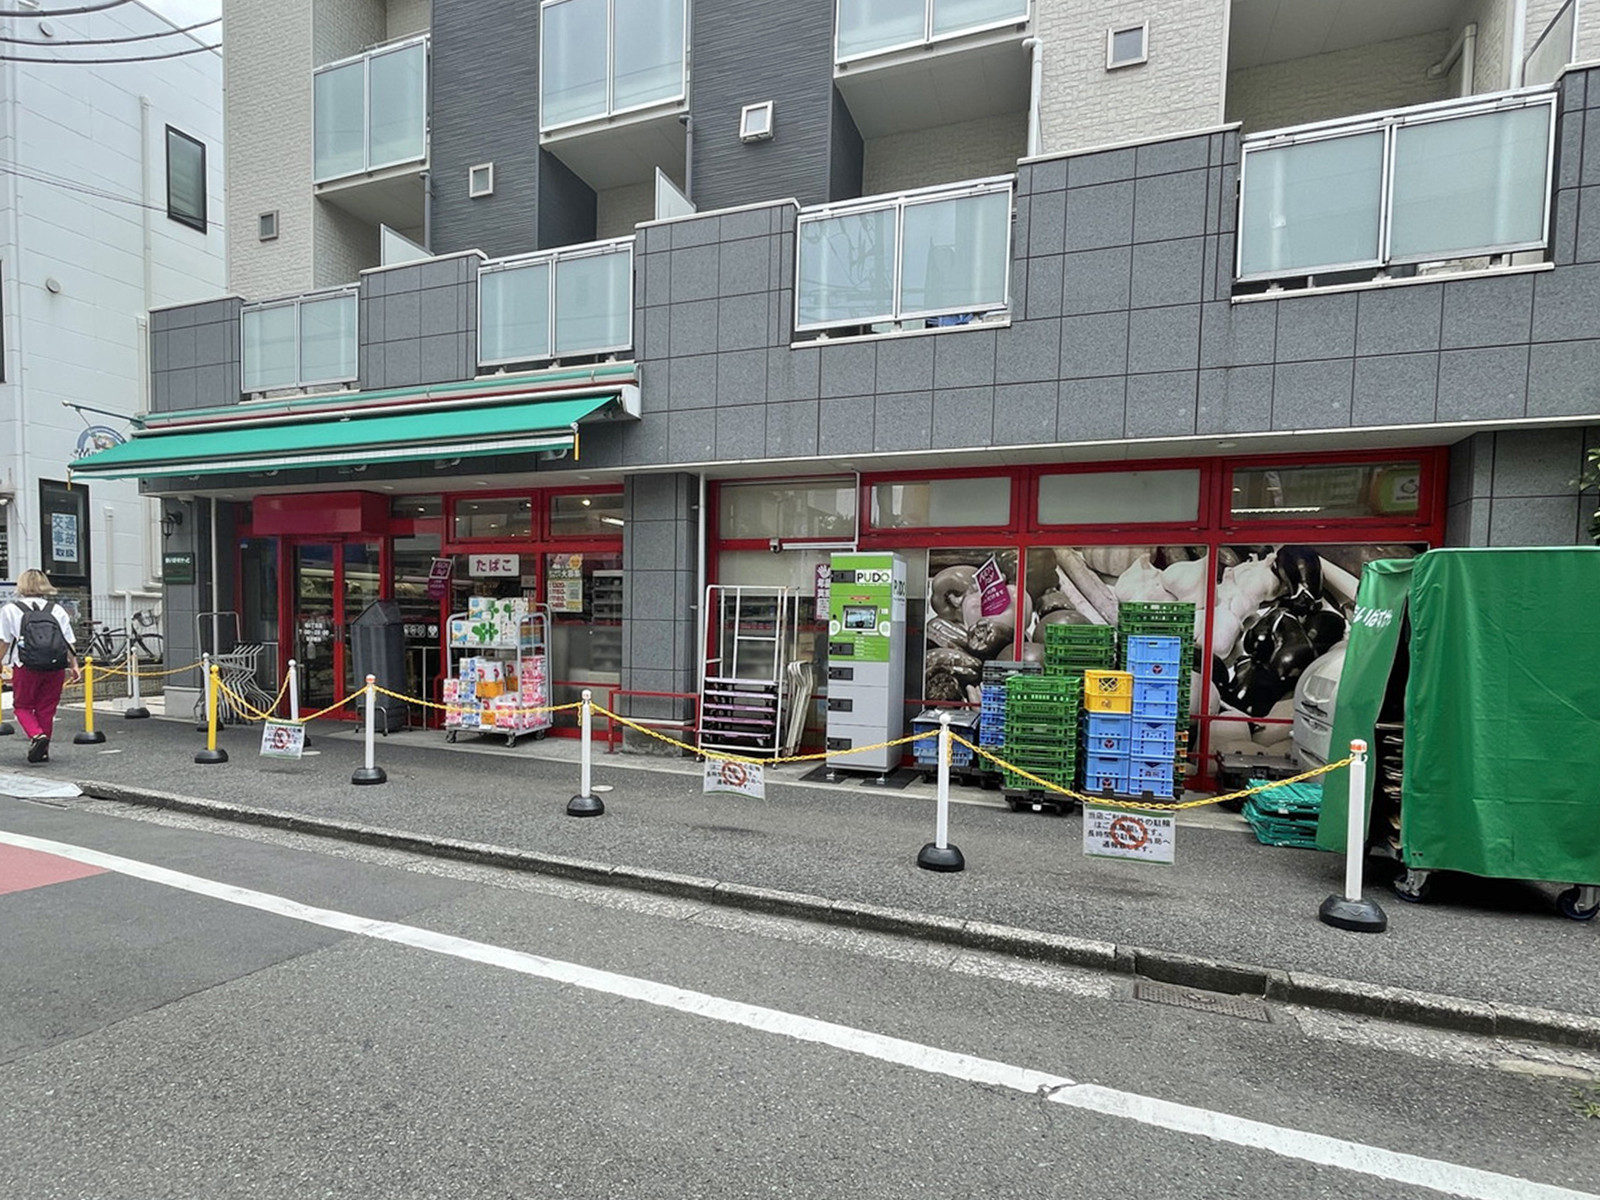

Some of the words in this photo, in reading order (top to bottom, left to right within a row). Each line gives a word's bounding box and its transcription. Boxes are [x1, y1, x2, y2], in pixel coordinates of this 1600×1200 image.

[53, 515, 75, 530] 交通
[53, 531, 75, 545] 事故
[476, 558, 513, 572] たばこ
[857, 572, 890, 582] PUDO
